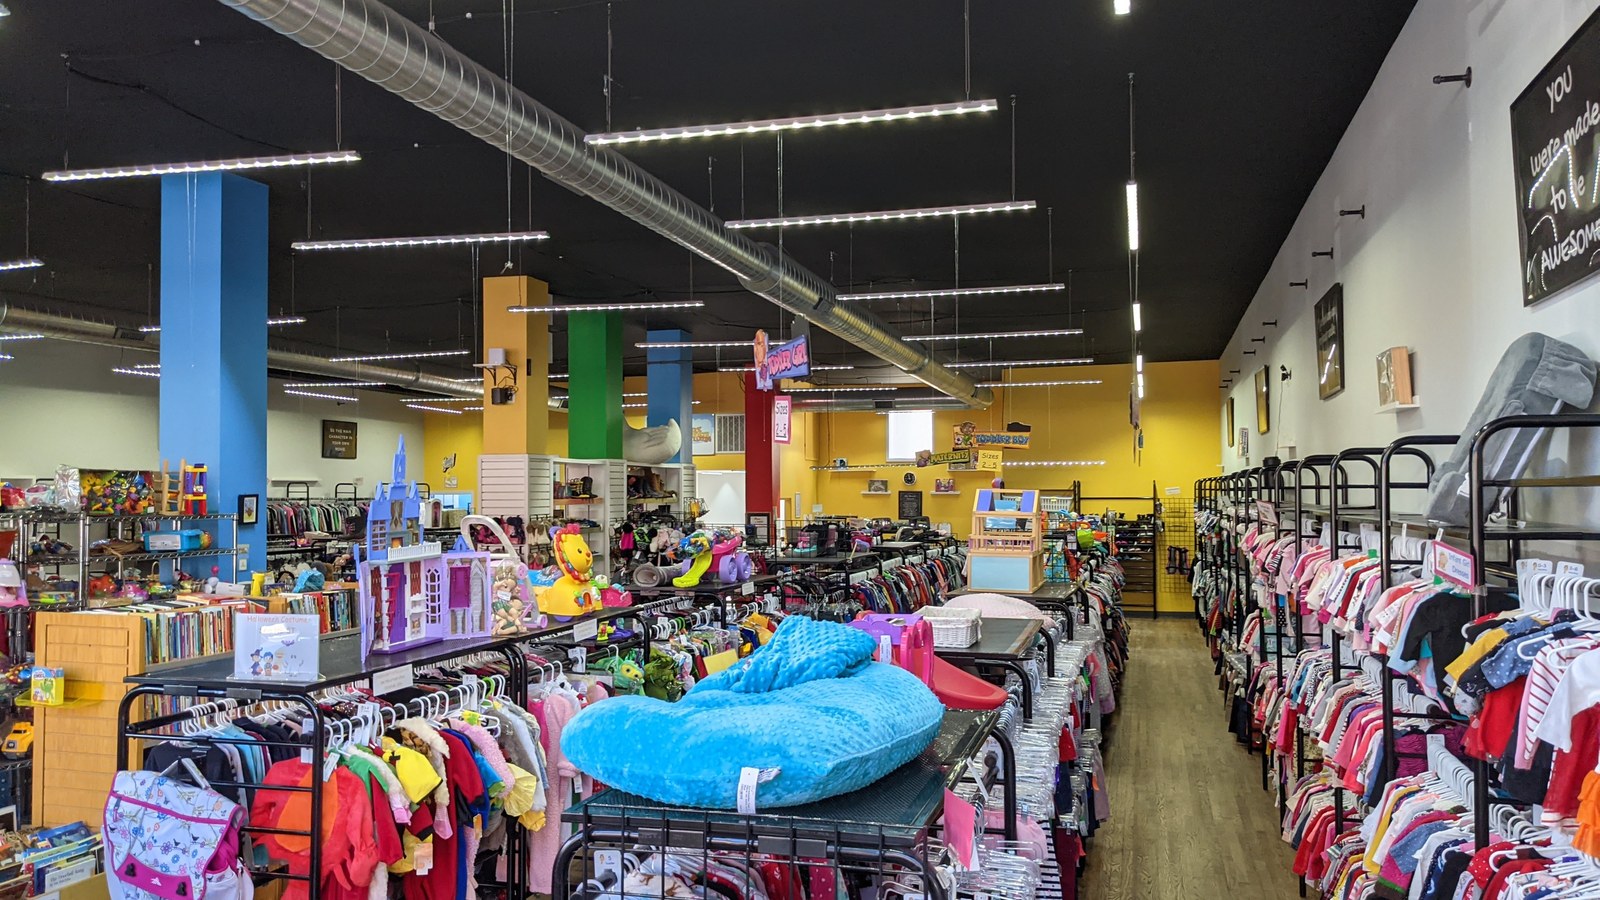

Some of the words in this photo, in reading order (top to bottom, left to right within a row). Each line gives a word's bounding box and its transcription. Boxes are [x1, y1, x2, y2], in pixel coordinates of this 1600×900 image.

[1546, 65, 1573, 114] YOU
[1530, 136, 1561, 177] were
[1564, 100, 1600, 148] made
[1550, 184, 1567, 215] to
[976, 433, 1011, 444] TODDLER
[1012, 434, 1030, 445] BOY
[981, 452, 999, 460] Sizes
